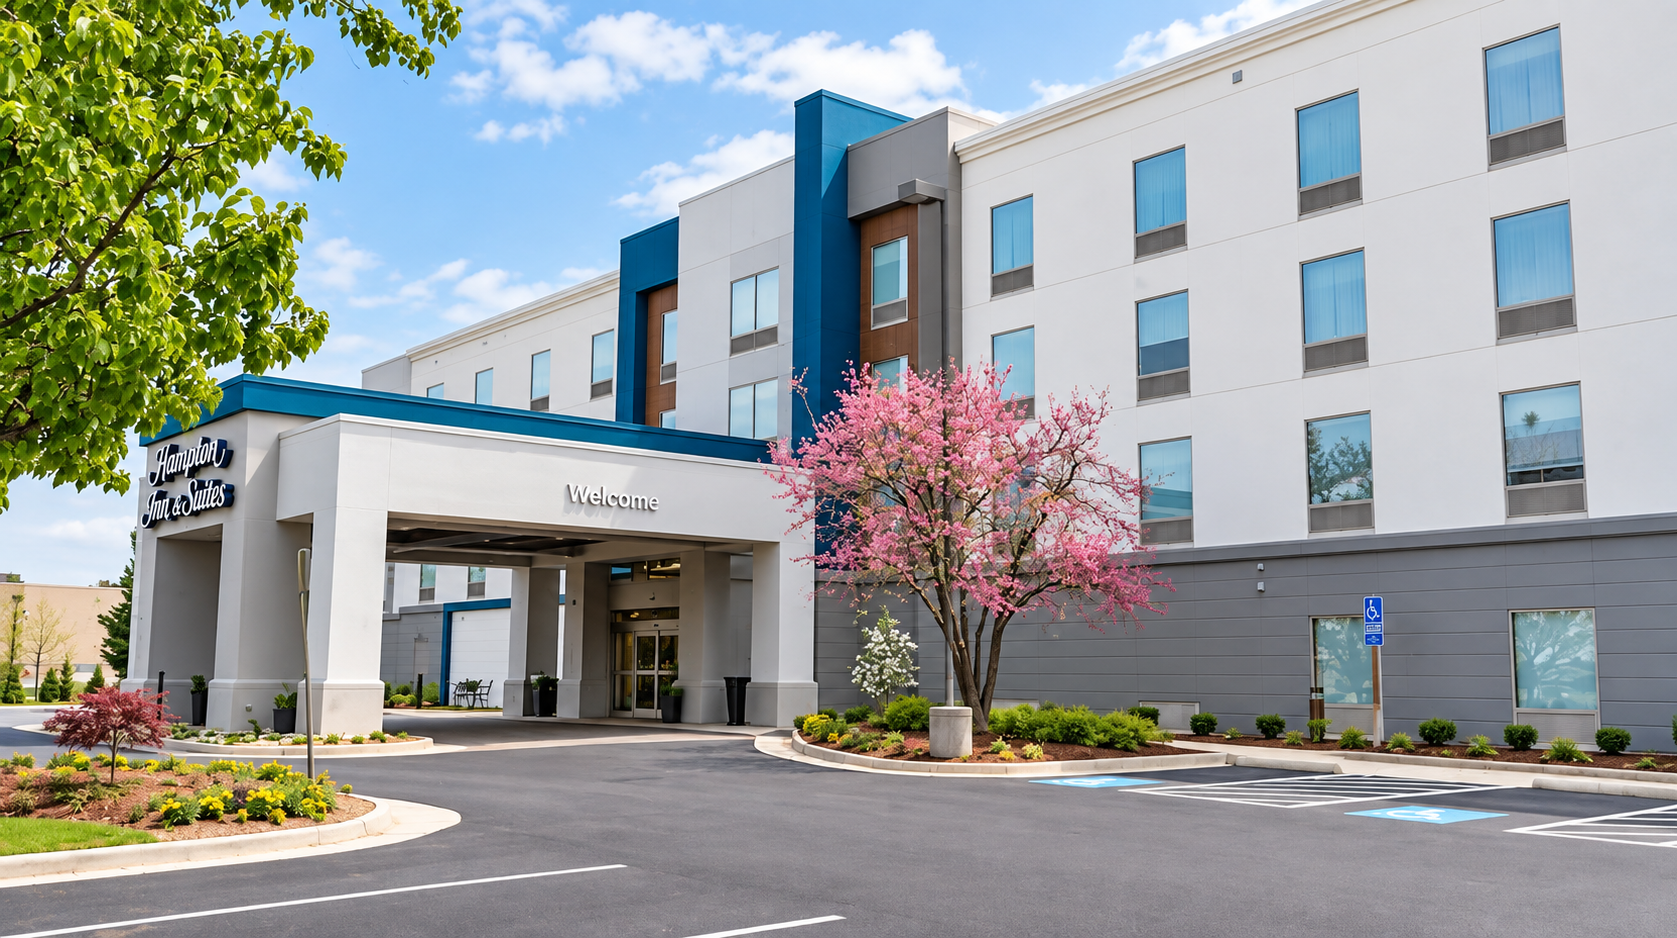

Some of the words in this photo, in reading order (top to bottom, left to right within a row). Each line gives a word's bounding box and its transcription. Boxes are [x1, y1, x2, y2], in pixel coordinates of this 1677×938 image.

[148, 436, 229, 487] Hampton
[141, 490, 172, 528] Inn
[172, 494, 182, 516] &
[182, 478, 229, 516] Suites
[566, 483, 660, 512] Welcome
